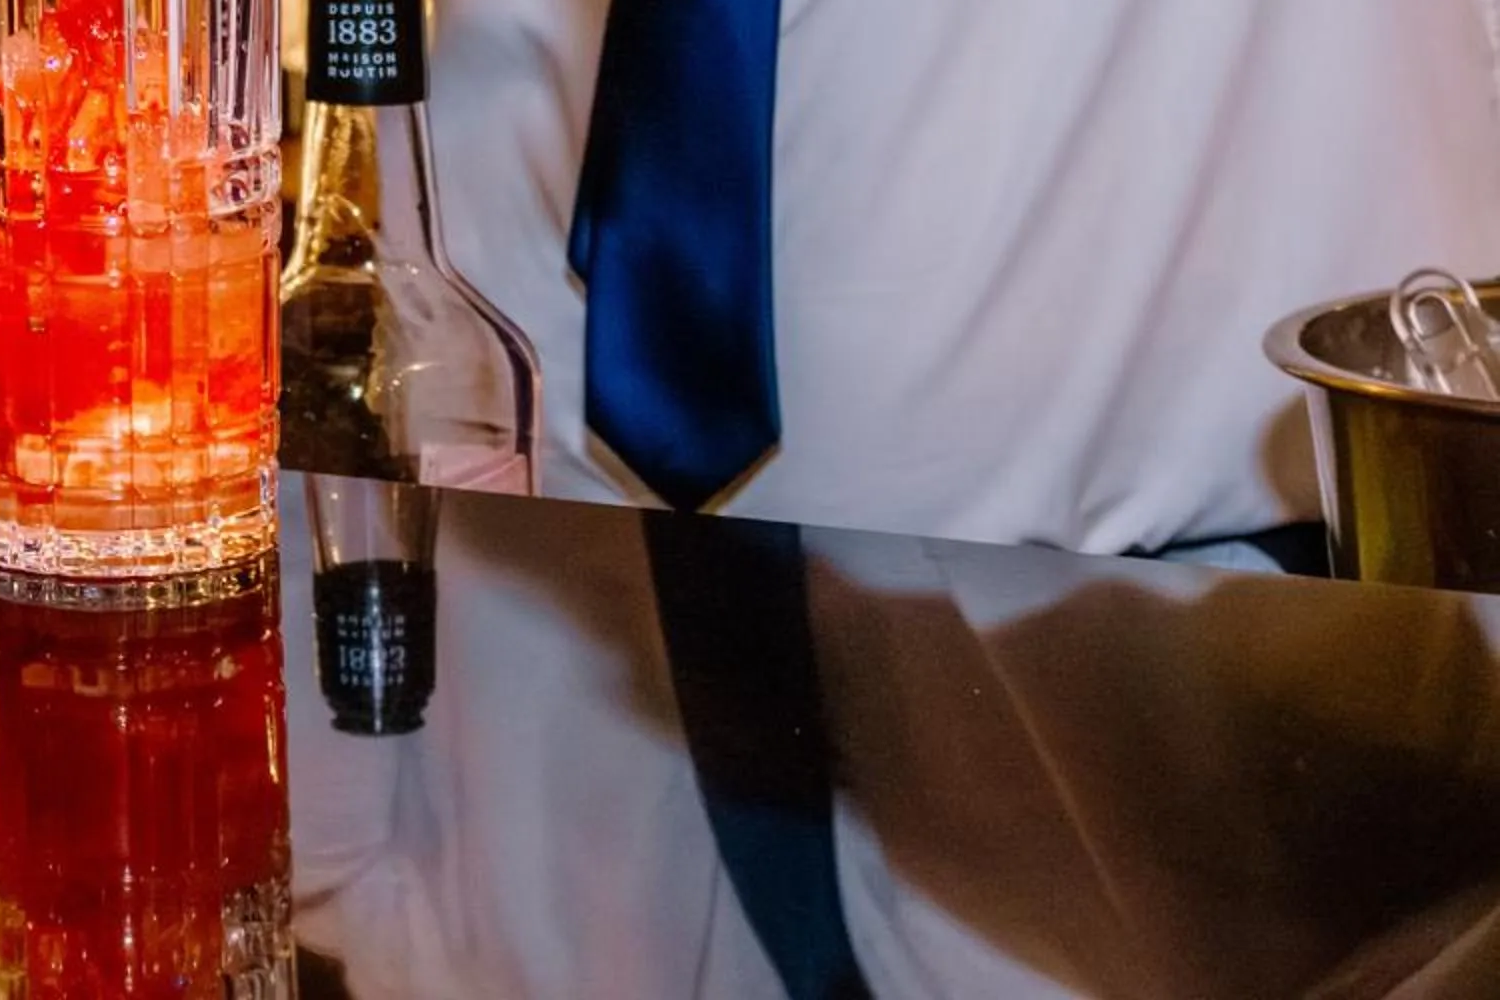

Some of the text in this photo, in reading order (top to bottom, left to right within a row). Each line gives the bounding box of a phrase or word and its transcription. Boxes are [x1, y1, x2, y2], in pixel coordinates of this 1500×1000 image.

[328, 3, 395, 15] DEPUIS
[328, 19, 397, 45] 1883
[328, 52, 396, 64] MAISON
[327, 66, 397, 78] ROUTIN
